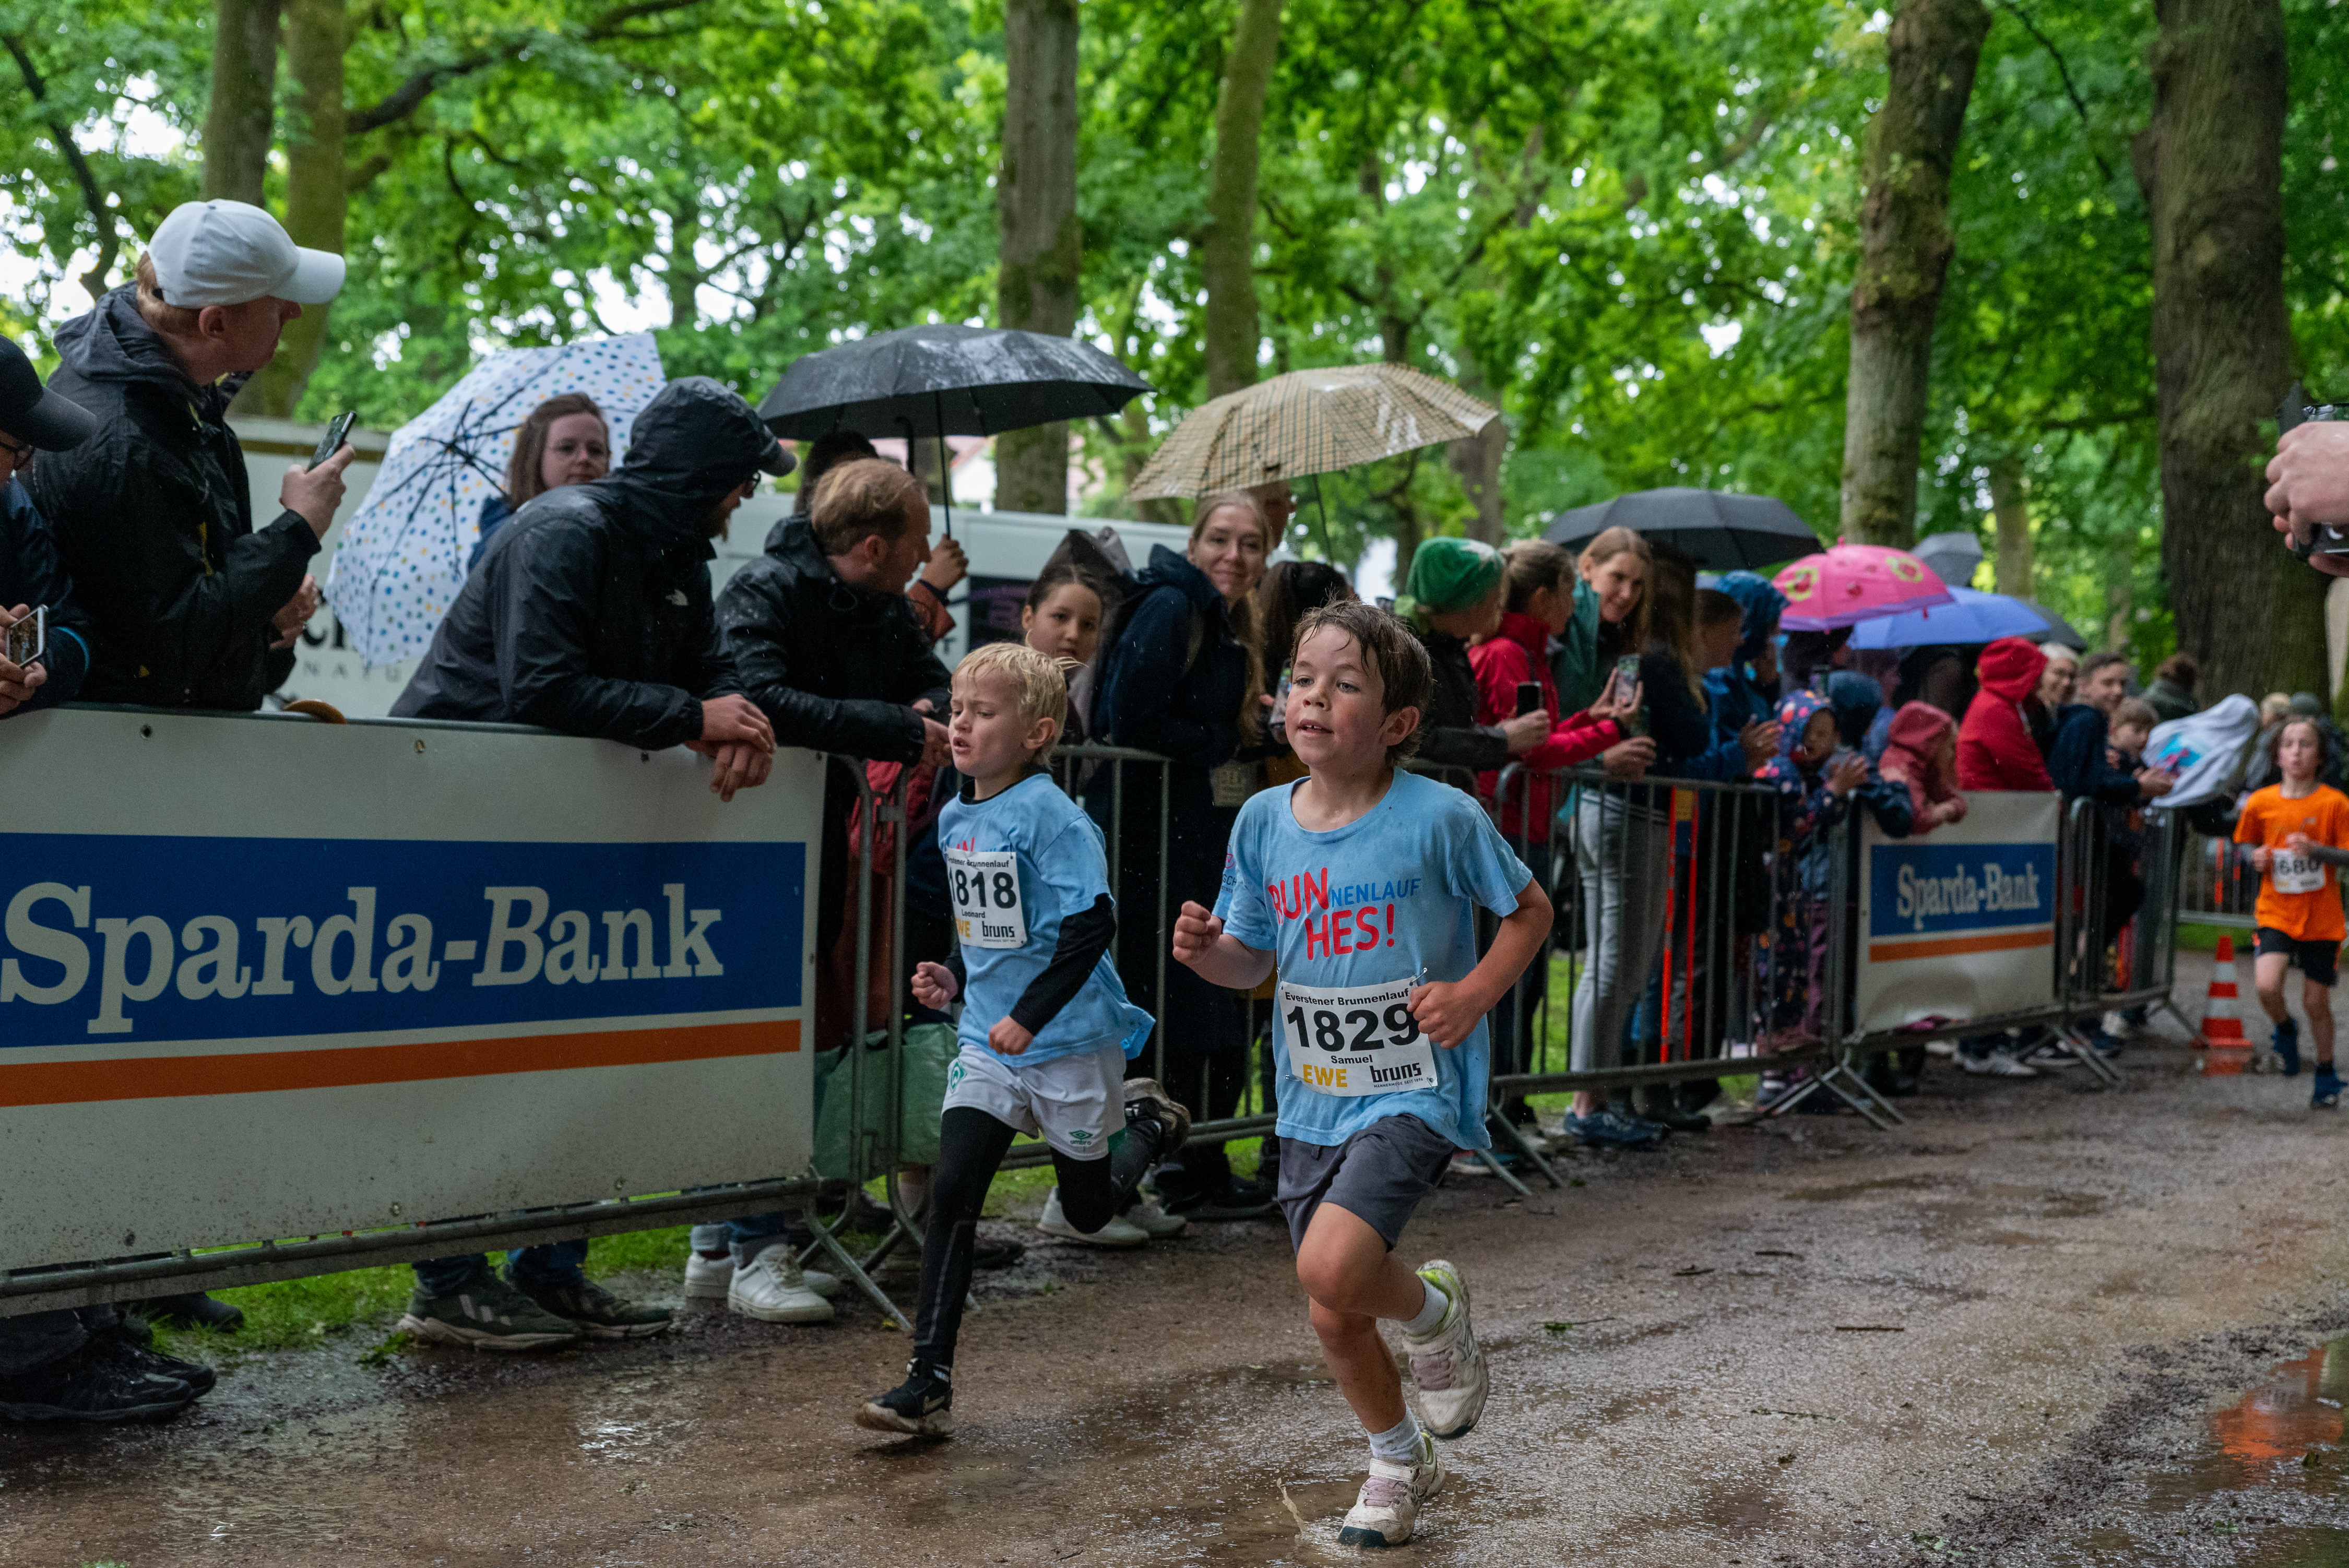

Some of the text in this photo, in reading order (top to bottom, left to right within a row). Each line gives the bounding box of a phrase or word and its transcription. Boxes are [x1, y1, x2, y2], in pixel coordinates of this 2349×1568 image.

[967, 859, 1009, 868] Brunnenlauf
[949, 866, 1016, 909] 1818
[1268, 867, 1421, 924] RUN NENLAUF
[1896, 862, 2040, 931] Sparda-Bank
[962, 909, 986, 918] Leonard
[982, 921, 1015, 937] bruns
[1304, 904, 1394, 960] HES!
[0, 882, 723, 1034] Sparda-Bank
[1285, 988, 1409, 1005] Everstener Brunnenlauf
[1287, 1003, 1421, 1052] 1829
[1331, 1054, 1373, 1064] Samuel
[1303, 1064, 1348, 1087] EWE
[1369, 1062, 1422, 1083] bruns
